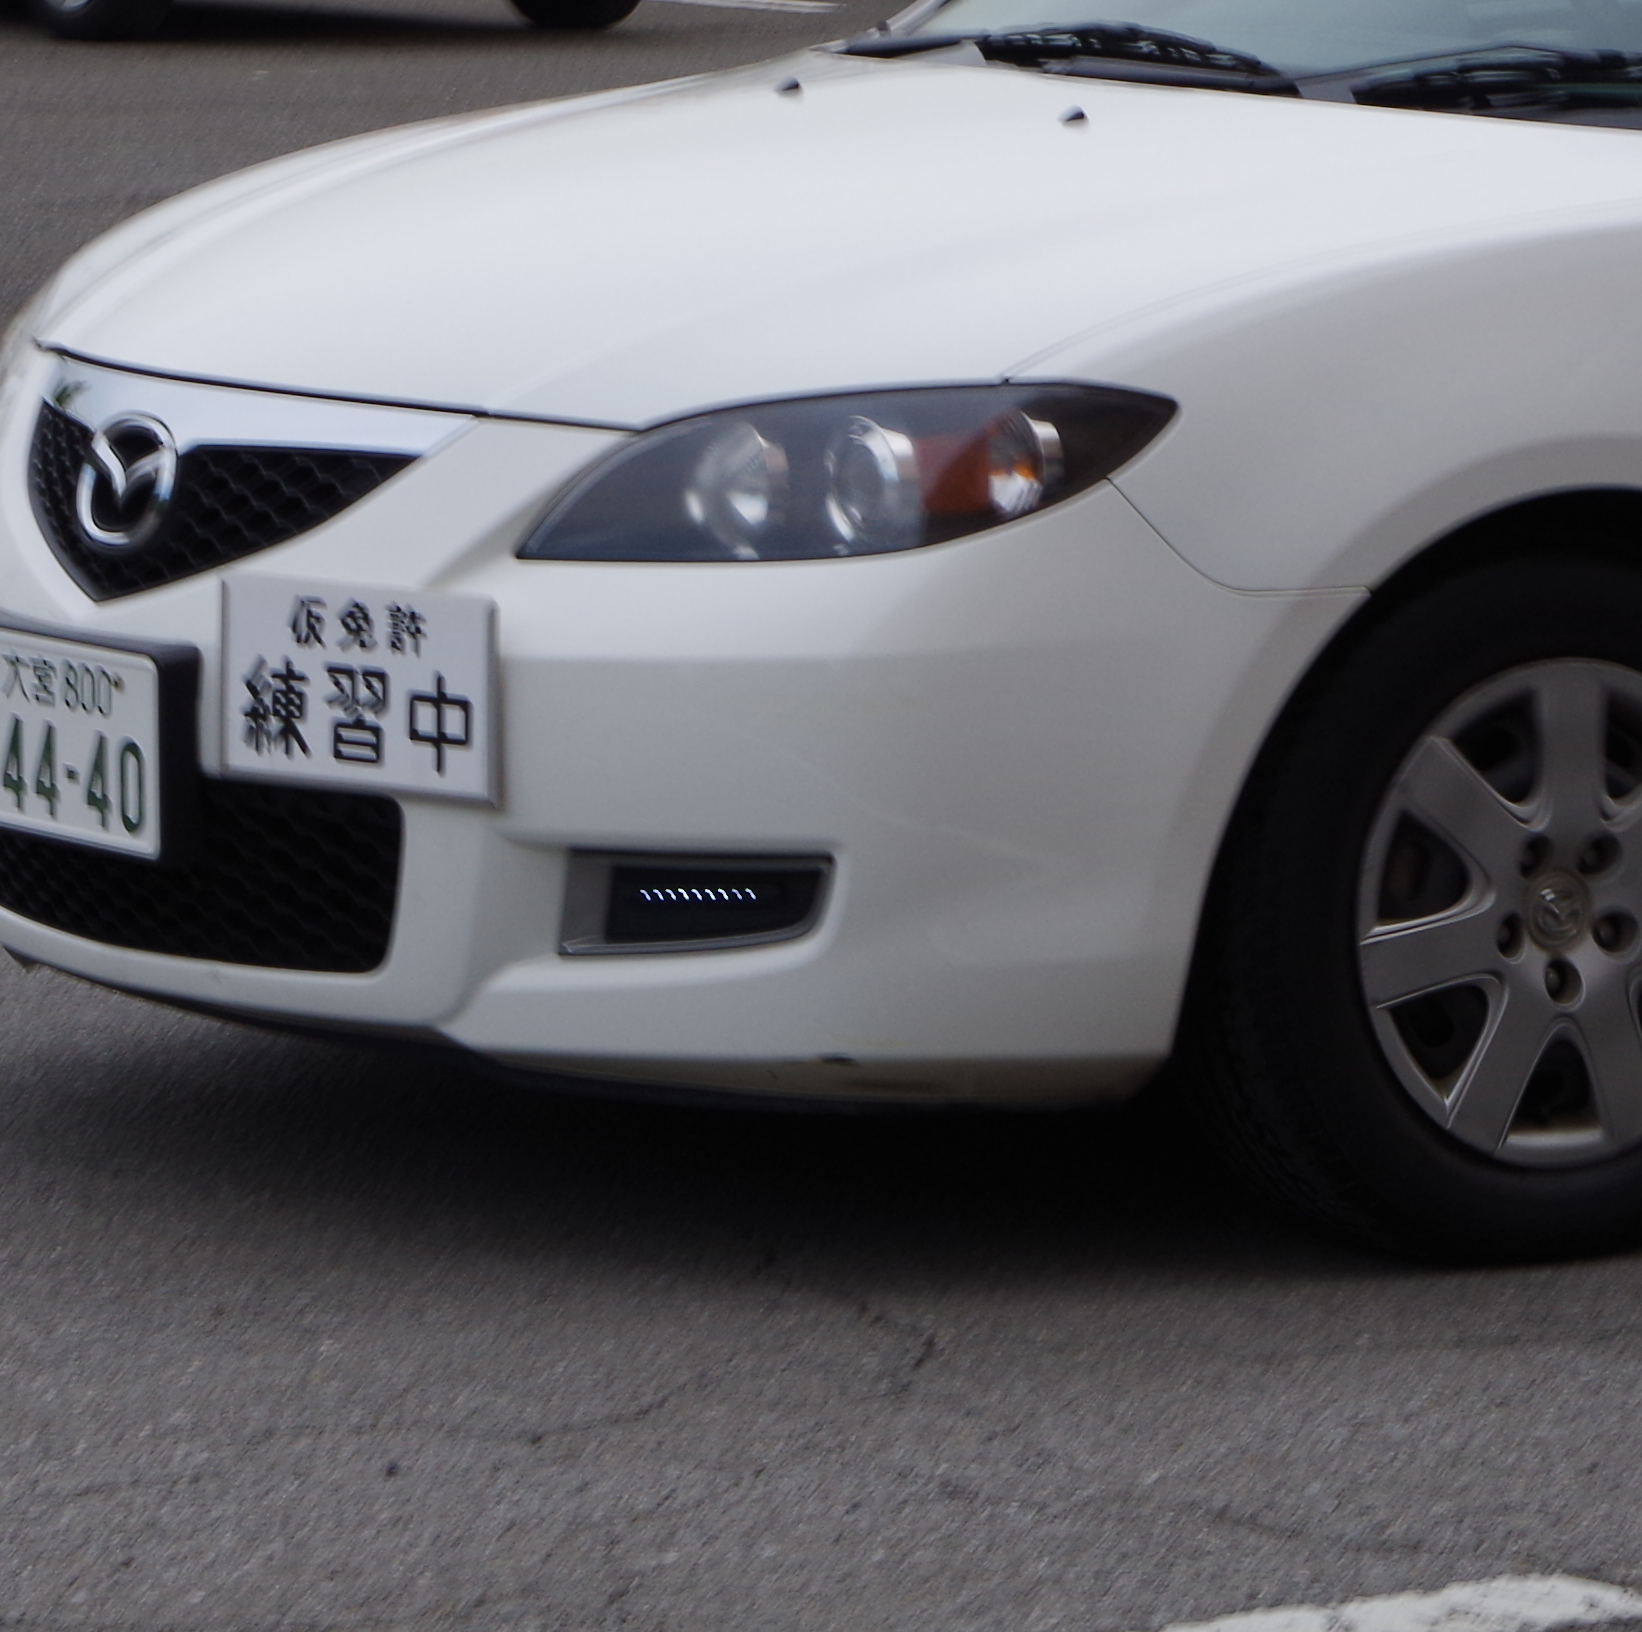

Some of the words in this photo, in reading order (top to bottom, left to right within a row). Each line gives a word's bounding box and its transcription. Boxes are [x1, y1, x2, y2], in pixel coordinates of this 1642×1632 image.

[290, 595, 425, 656] 仮免許
[1, 649, 57, 706] 大宮
[63, 660, 113, 716] 800
[242, 655, 475, 773] 練習中
[2, 712, 145, 833] 44-40
